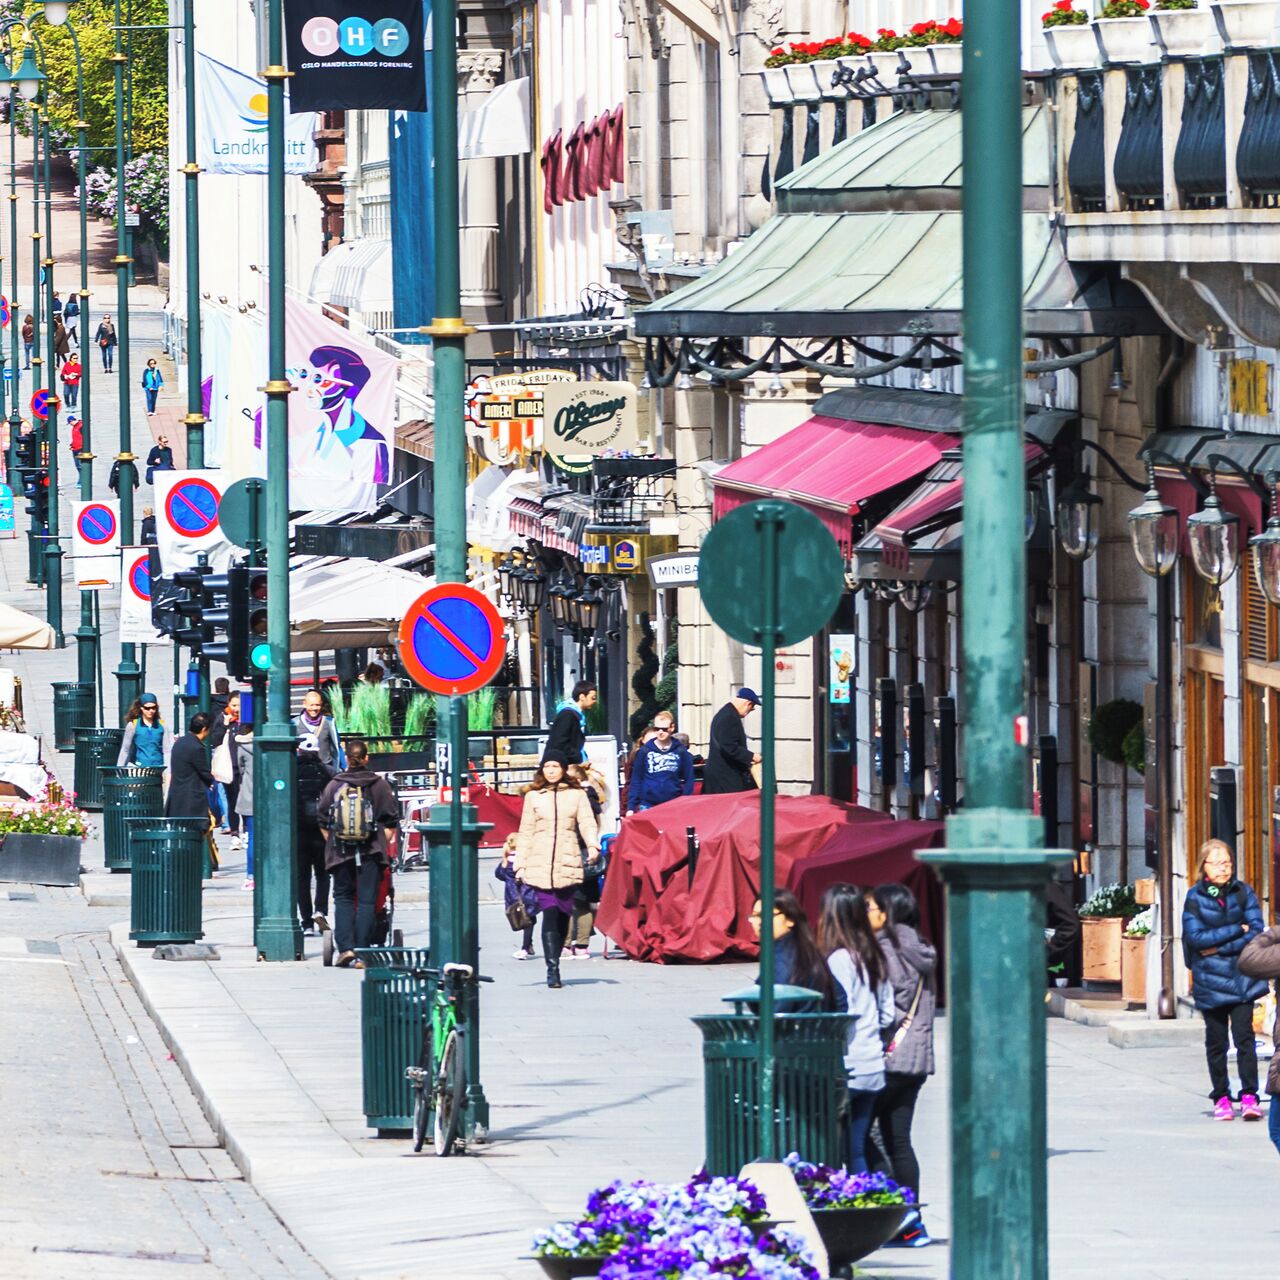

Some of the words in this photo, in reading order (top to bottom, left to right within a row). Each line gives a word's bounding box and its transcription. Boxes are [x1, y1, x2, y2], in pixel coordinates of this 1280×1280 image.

[301, 61, 320, 69] OSLO
[379, 61, 413, 69] FORENING
[212, 138, 307, 156] Landkritt
